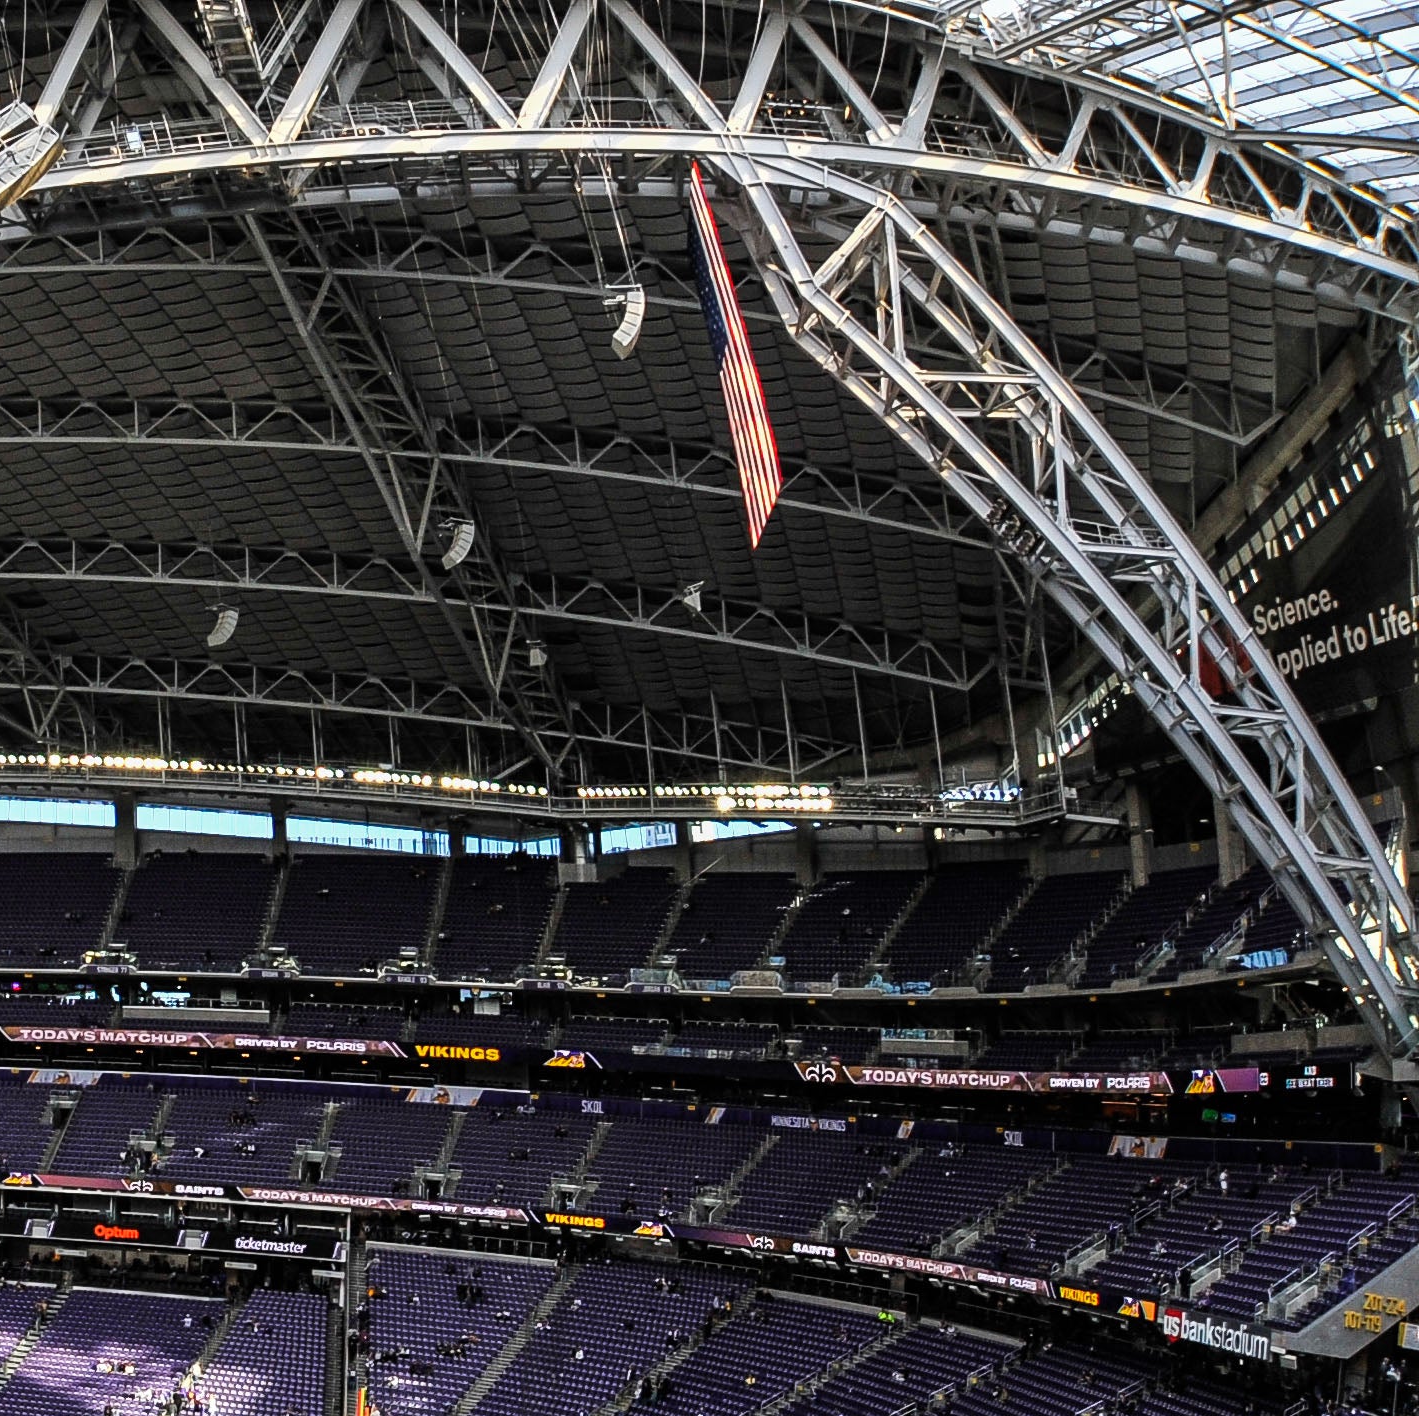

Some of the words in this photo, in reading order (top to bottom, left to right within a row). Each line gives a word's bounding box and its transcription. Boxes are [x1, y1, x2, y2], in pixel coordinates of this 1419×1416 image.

[1253, 589, 1338, 635] Science.
[1343, 624, 1367, 653] to
[1368, 603, 1418, 646] Life.
[20, 1028, 95, 1042] TODAY'S
[99, 1031, 188, 1044] MATCHUP
[234, 1038, 278, 1048] DRIVEN
[280, 1039, 297, 1049] BY
[306, 1040, 366, 1052] POLARIS
[415, 1044, 501, 1061] VIKINGS
[863, 1069, 932, 1085] TODAY'S
[935, 1073, 1010, 1088] MATCHUP
[1050, 1078, 1084, 1088] DRIVEN
[1086, 1079, 1100, 1089] BY
[1106, 1077, 1150, 1089] POLARIS
[582, 1100, 604, 1114] SKOL
[771, 1114, 809, 1128] MINNESOTA
[818, 1118, 846, 1131] VIKINGS
[1004, 1131, 1023, 1146] SKOL
[175, 1184, 224, 1196] SAINTS
[252, 1189, 310, 1202] TODAY'S
[312, 1192, 377, 1206] MATCHUP
[463, 1206, 507, 1218] POLARIS
[545, 1213, 605, 1229] VIKINGS
[94, 1224, 139, 1240] Optum
[234, 1236, 307, 1254] ticketmaster
[792, 1242, 836, 1257] SAINTS
[857, 1251, 904, 1267] TODAY'S
[906, 1259, 953, 1276] MATCHUP
[1060, 1286, 1100, 1306] VIKINGS
[1364, 1293, 1407, 1317] 201-224
[1345, 1310, 1382, 1333] 107-119
